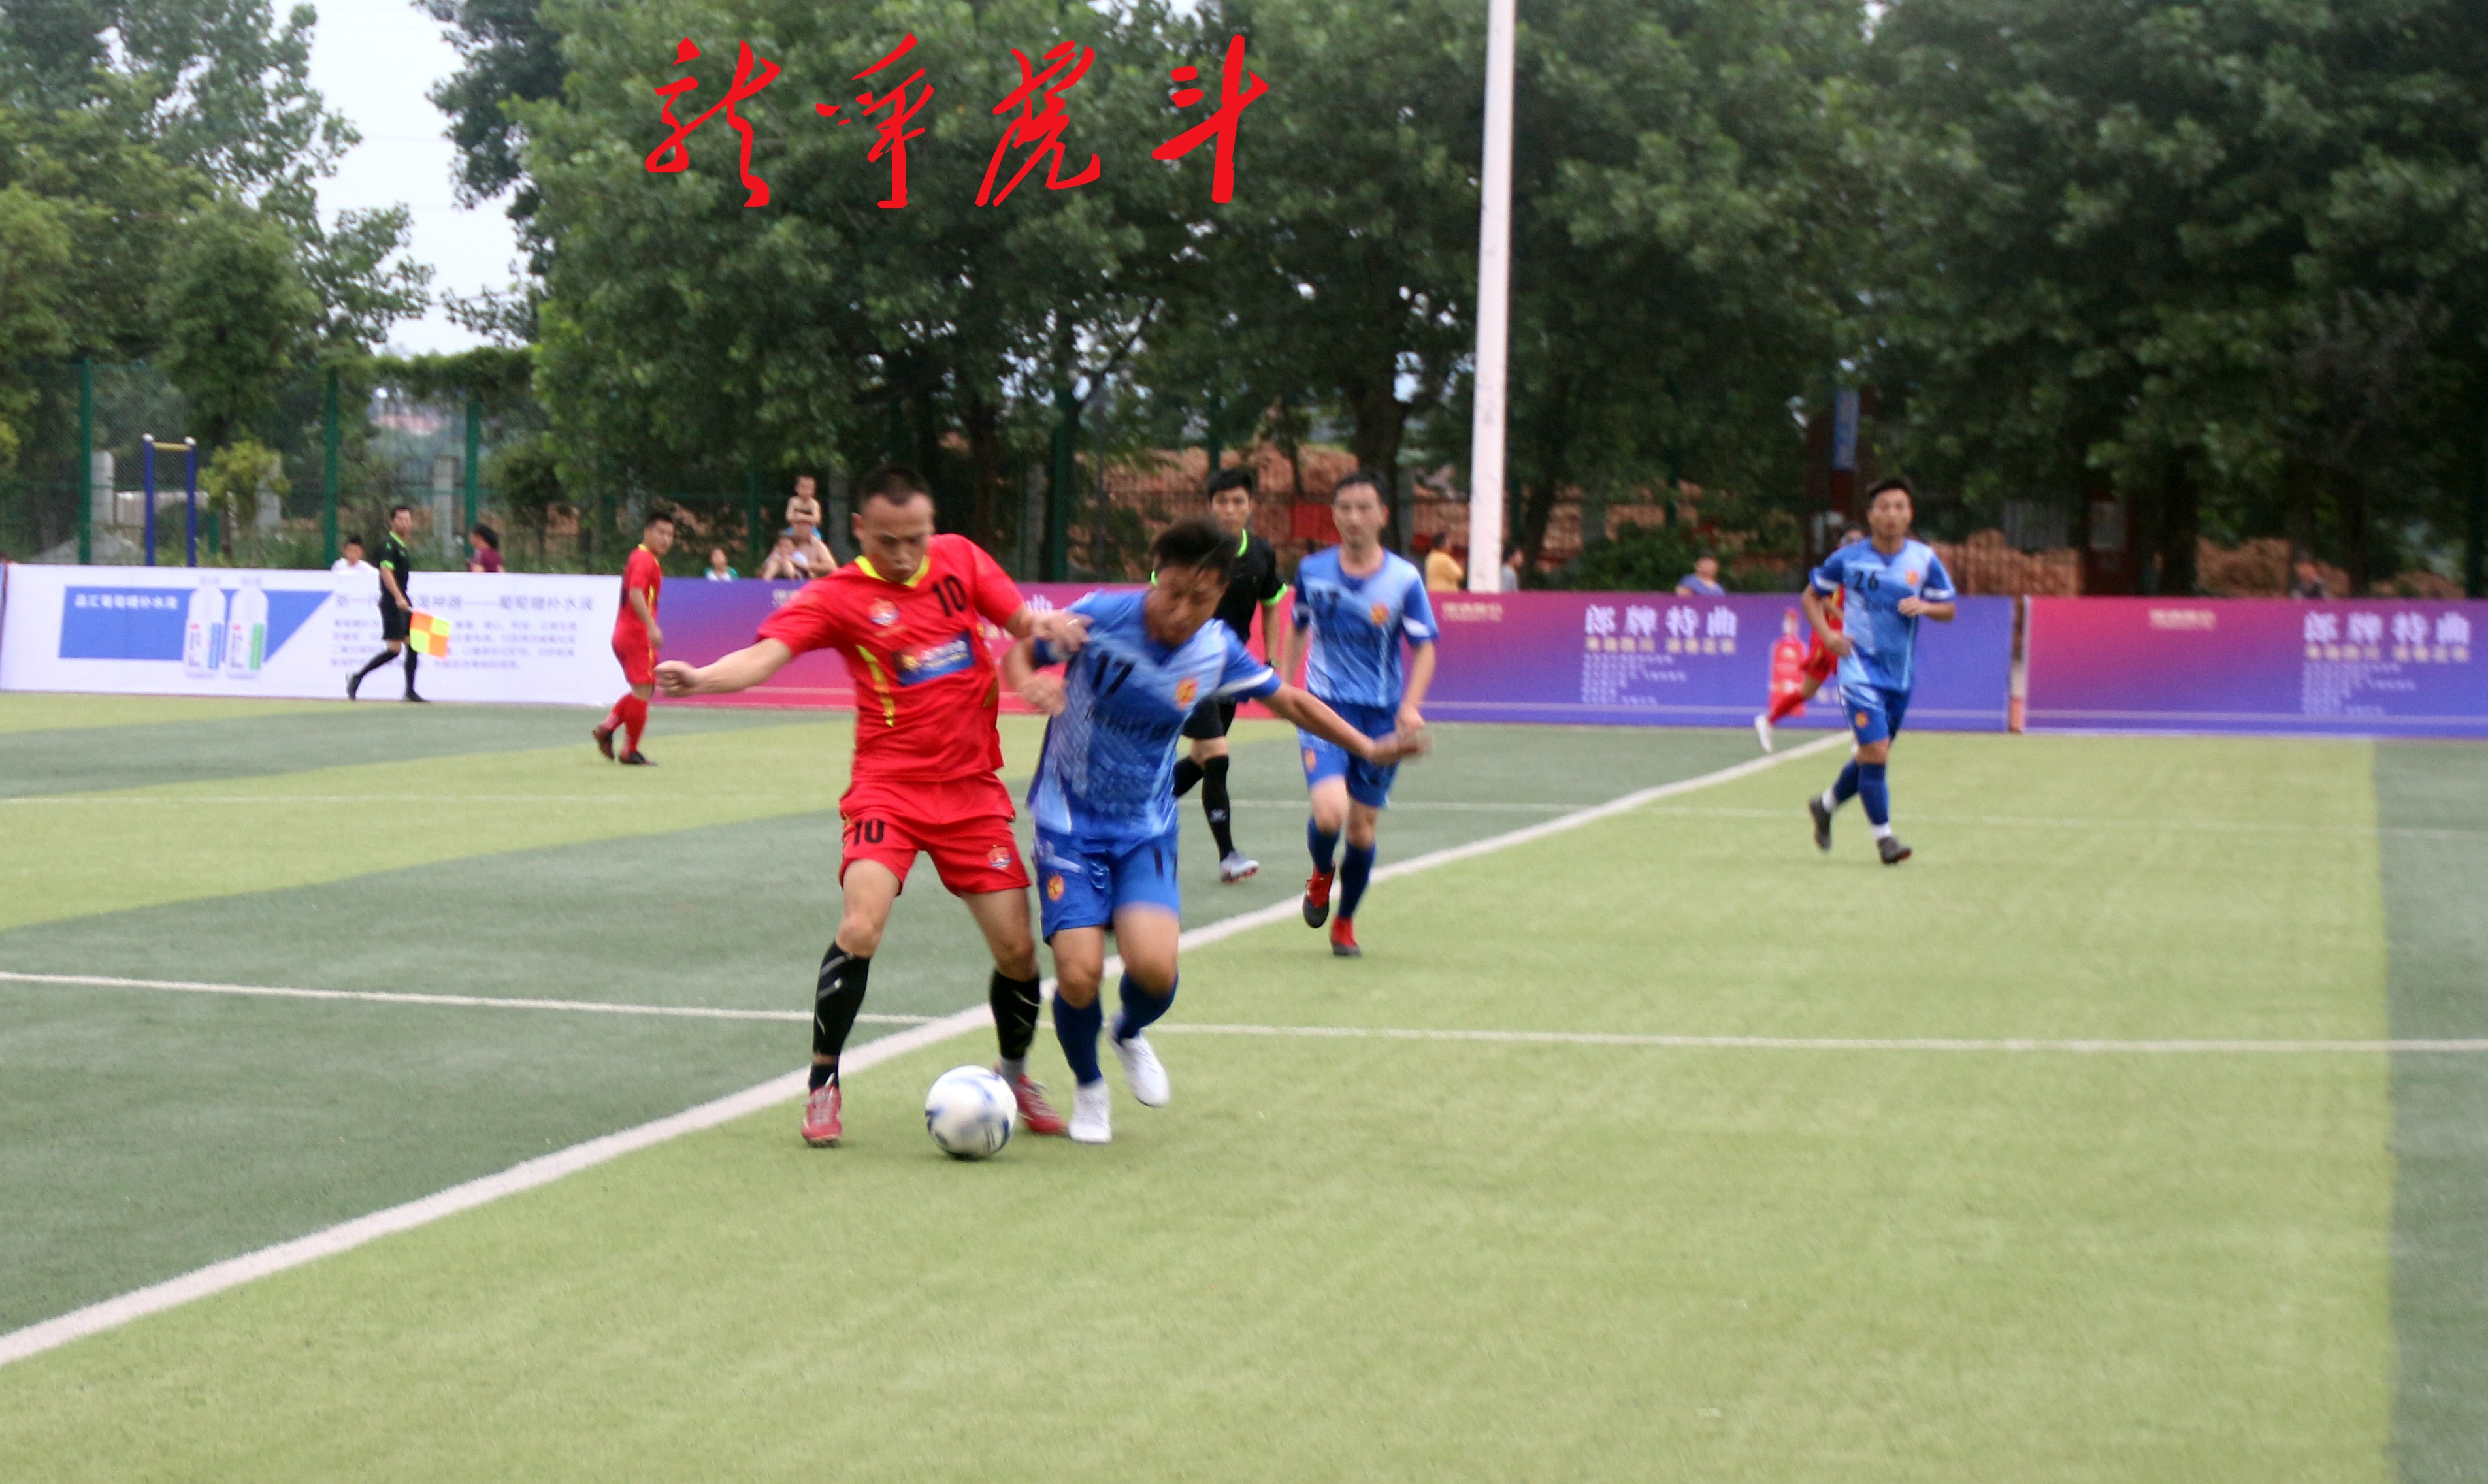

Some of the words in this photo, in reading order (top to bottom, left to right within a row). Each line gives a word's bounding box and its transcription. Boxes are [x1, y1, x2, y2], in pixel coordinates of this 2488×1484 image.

[932, 575, 967, 617] 10
[1091, 651, 1135, 698] 17
[853, 818, 885, 845] 10
